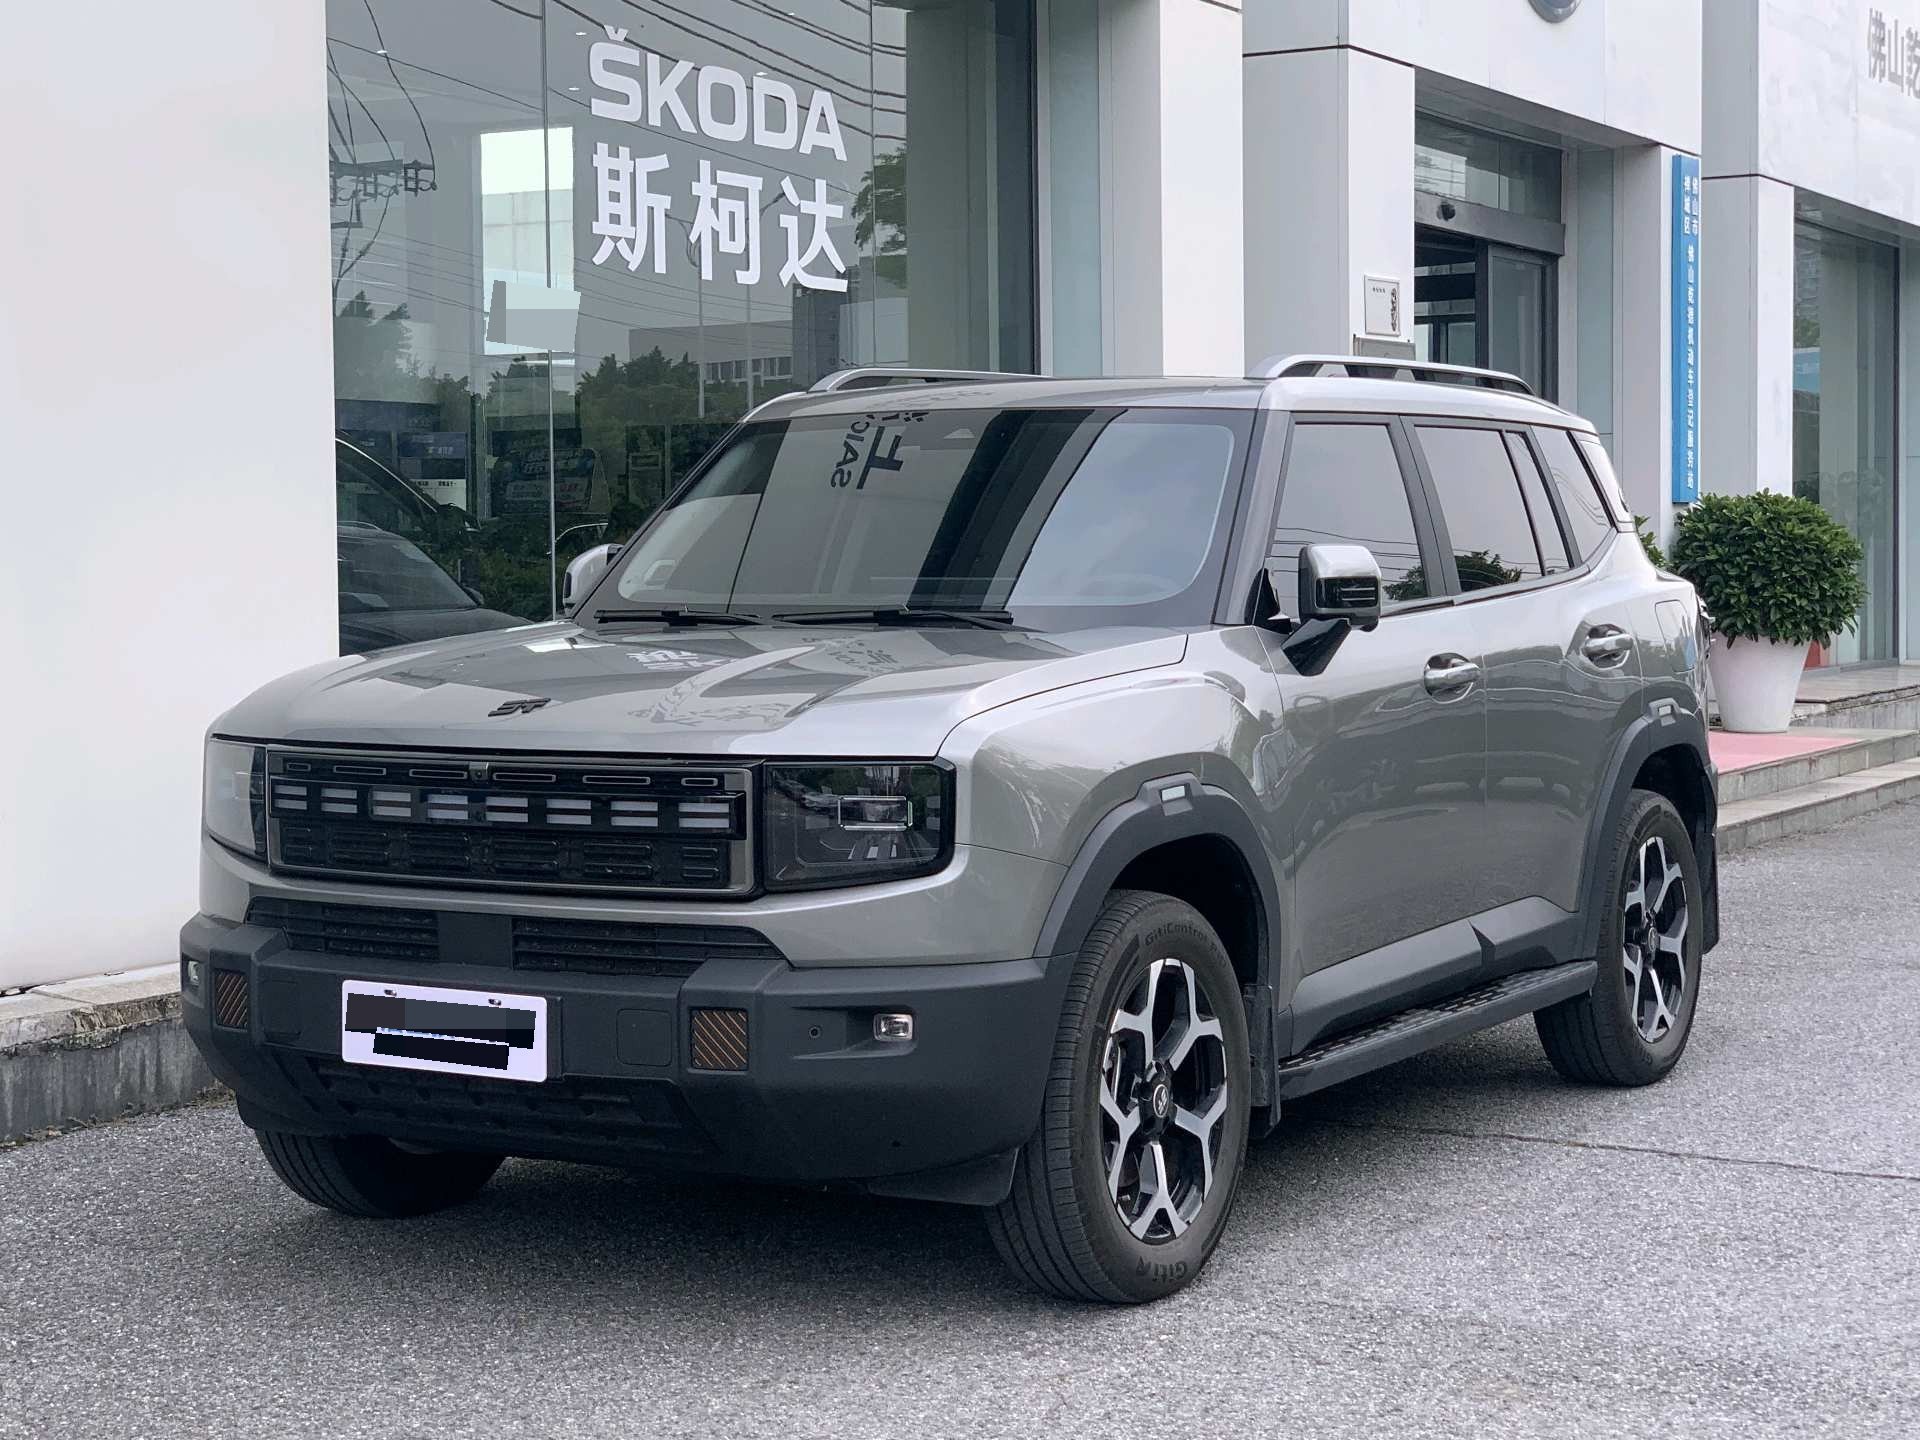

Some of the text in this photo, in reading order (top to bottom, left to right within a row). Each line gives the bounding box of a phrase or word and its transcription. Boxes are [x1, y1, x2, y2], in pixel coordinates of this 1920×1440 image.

[589, 24, 848, 162] ŠKODA
[592, 142, 848, 292] 斯柯达
